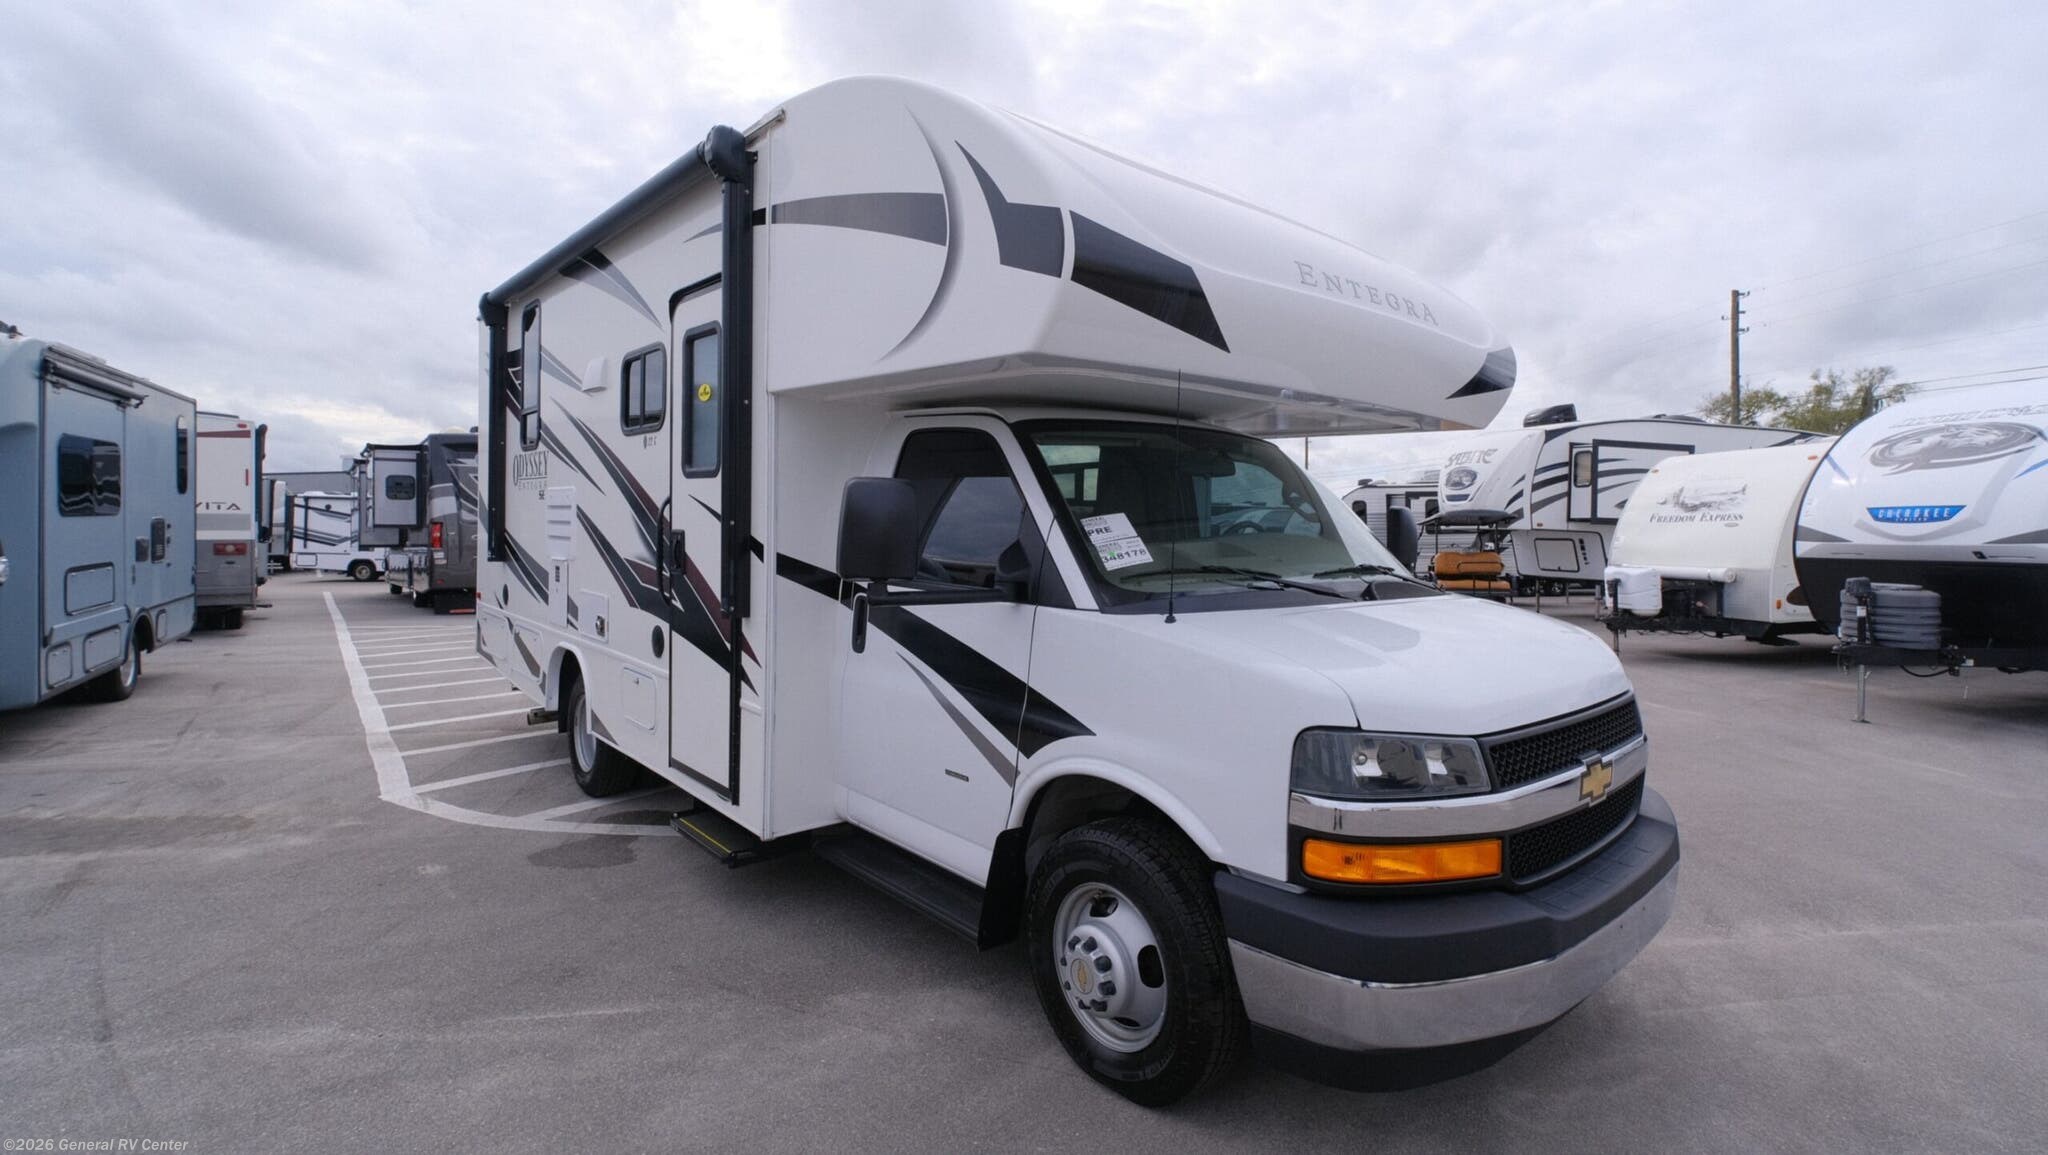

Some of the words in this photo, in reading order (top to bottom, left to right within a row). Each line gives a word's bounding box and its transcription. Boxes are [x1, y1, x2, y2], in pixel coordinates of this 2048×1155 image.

[1294, 260, 1439, 326] ENTEGRA
[513, 451, 549, 486] ODYSSEY
[1649, 513, 1696, 523] FREEDOM
[1700, 511, 1744, 521] EXPRESS
[1087, 526, 1112, 537] PRE
